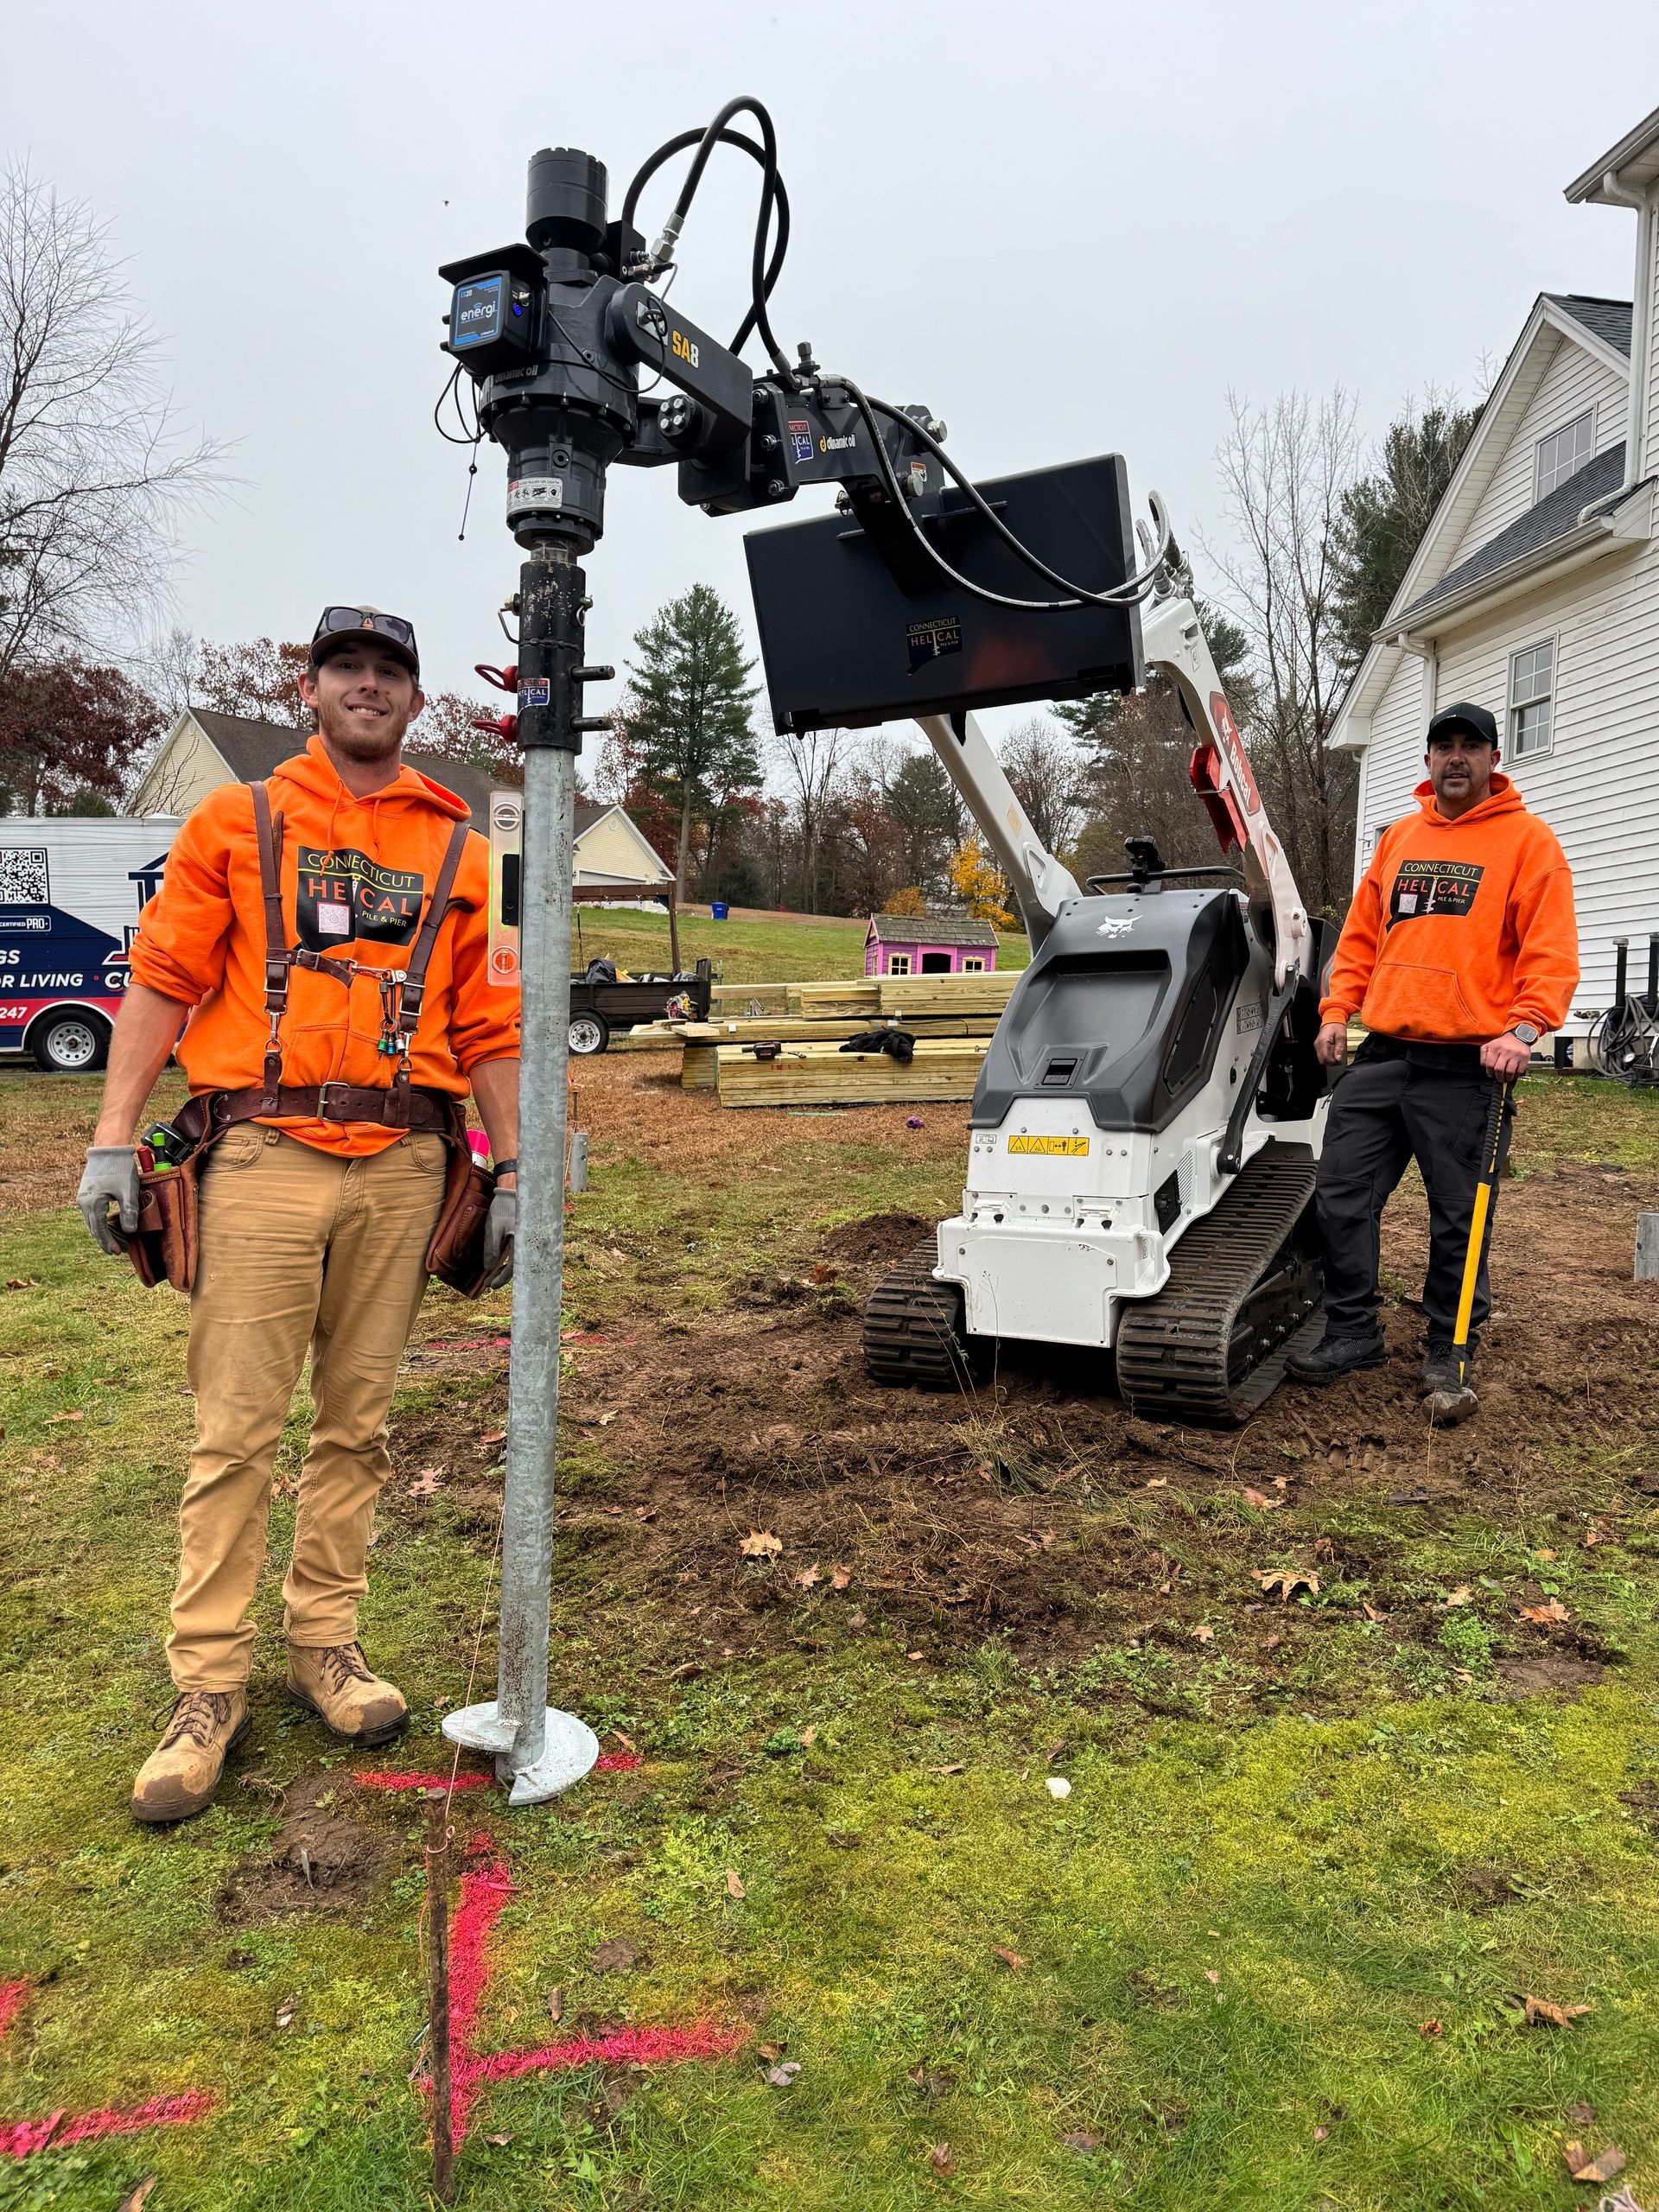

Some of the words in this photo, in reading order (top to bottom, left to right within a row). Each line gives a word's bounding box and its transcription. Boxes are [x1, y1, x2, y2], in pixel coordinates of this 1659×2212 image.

[461, 301, 496, 321] energi
[525, 365, 539, 376] oil
[827, 435, 849, 450] dinamic
[909, 617, 957, 632] CONNECTICUT
[1230, 740, 1252, 810] Bobcat
[1404, 862, 1478, 877] CONNECTICUT
[26, 918, 45, 929] PRO
[361, 910, 378, 921] PILE
[390, 918, 407, 927] PIER
[20, 974, 83, 988] LIVING
[0, 1007, 28, 1019] 247
